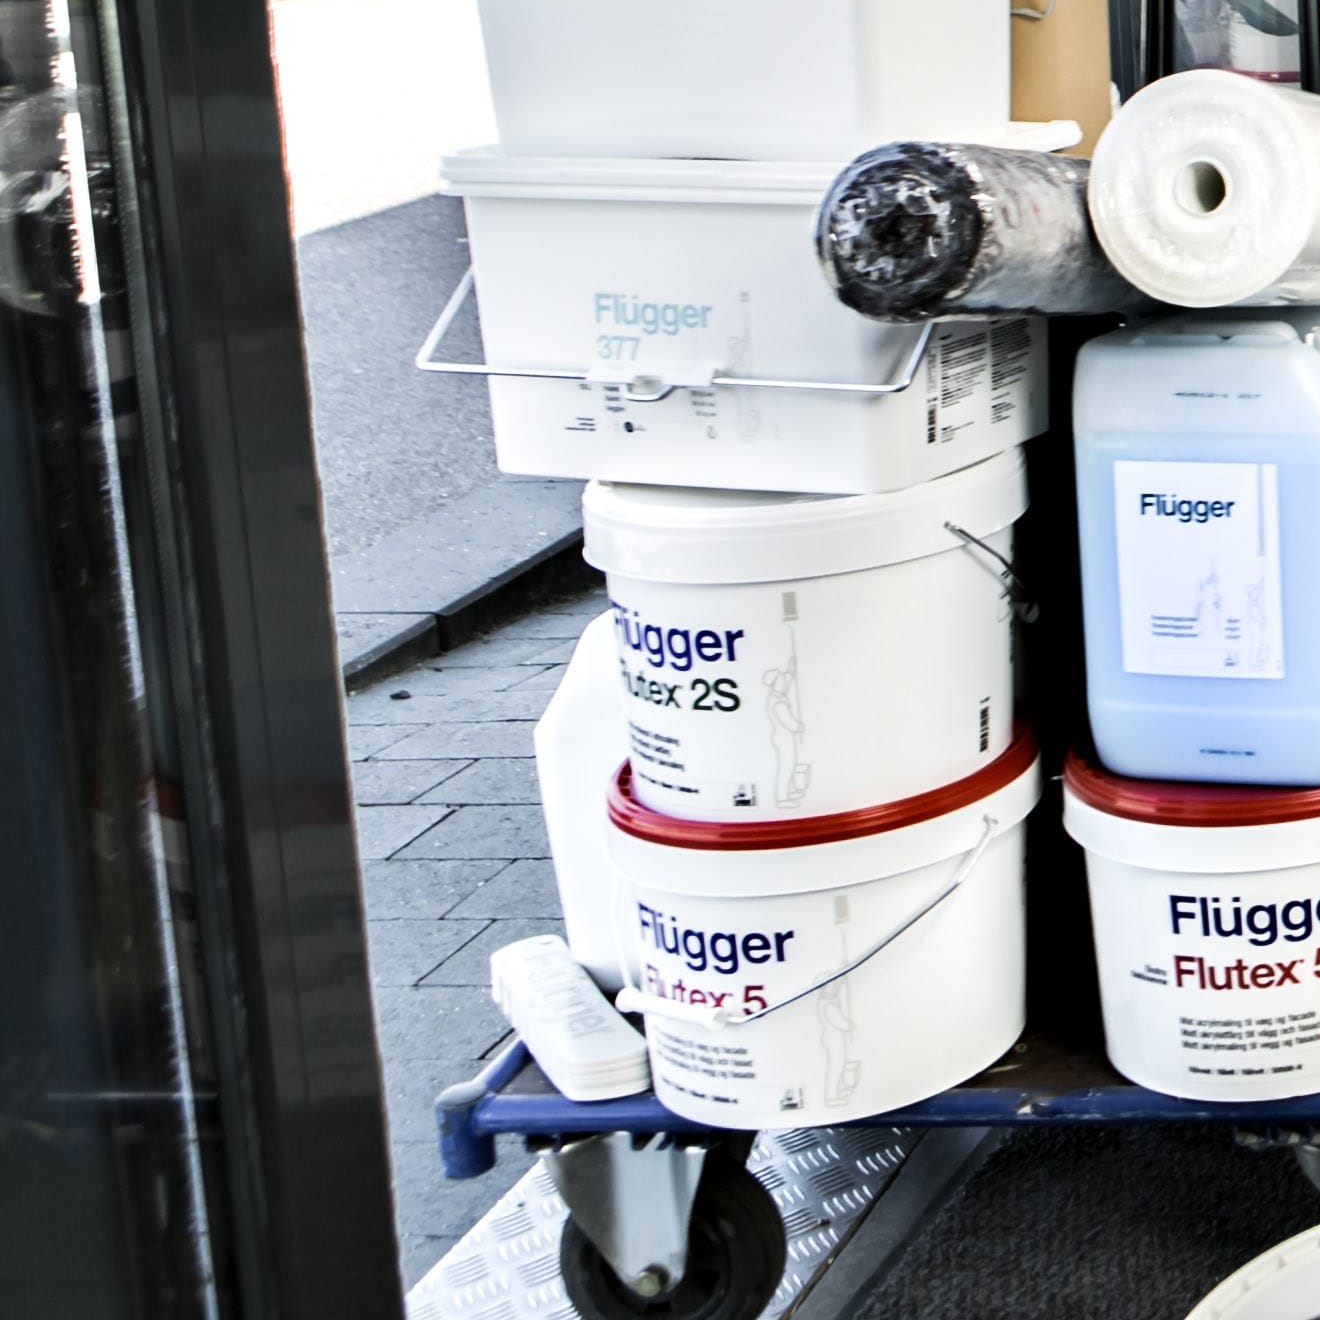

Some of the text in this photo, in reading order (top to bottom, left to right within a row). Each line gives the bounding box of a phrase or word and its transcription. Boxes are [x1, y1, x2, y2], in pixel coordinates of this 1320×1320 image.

[594, 292, 713, 336] Flügger
[596, 335, 641, 362] 377
[1140, 494, 1236, 523] Flügger
[610, 600, 744, 672] Flügger
[691, 678, 741, 712] 2S
[637, 901, 794, 976] Flügger
[1174, 955, 1301, 990] Flutex
[742, 983, 768, 1017] 5
